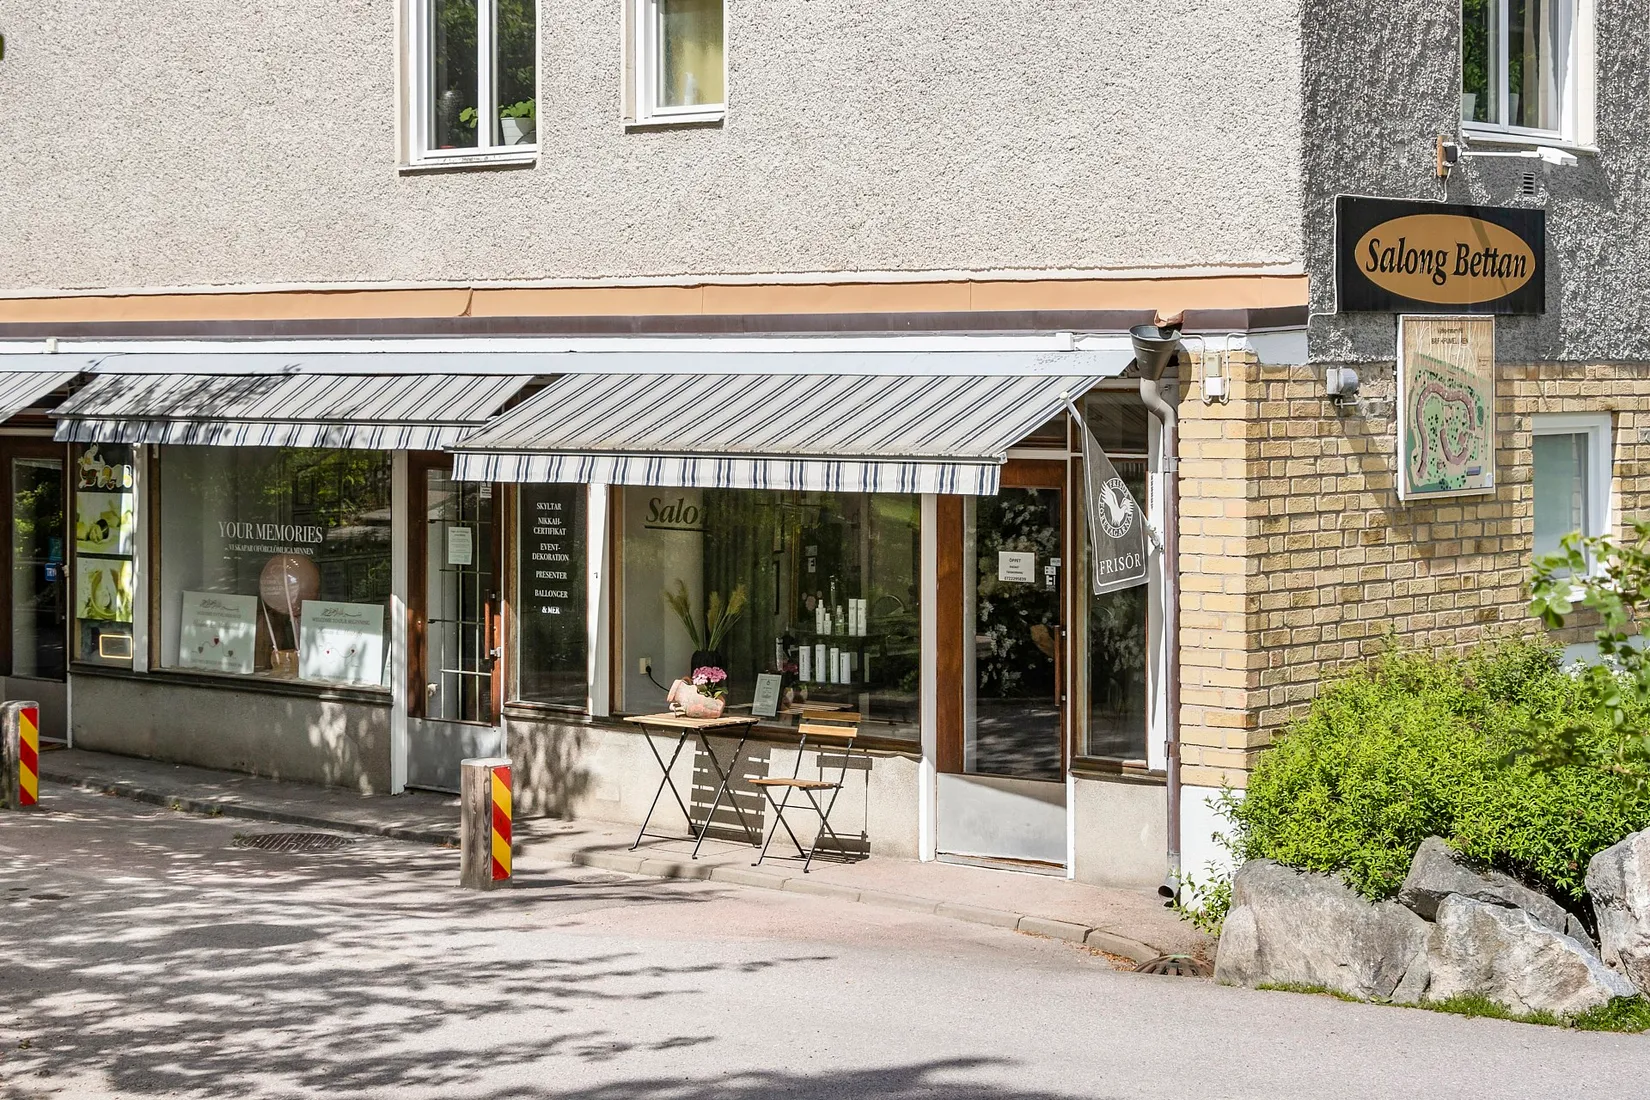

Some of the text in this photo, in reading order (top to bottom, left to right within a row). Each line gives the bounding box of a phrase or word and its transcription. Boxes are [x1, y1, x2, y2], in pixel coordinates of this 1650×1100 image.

[1365, 236, 1528, 286] Salong Bettan
[536, 502, 562, 510] SKYLTAR
[537, 517, 562, 525] NIKKAH-
[218, 521, 324, 544] YOUR MEMORIES
[533, 527, 567, 536] CERTIFIKAT
[540, 543, 561, 551] EVENT-
[532, 552, 569, 562] DEKORATION
[1099, 552, 1142, 575] FRISÖR
[535, 570, 568, 580] PRESENTER
[534, 589, 569, 599] BALLONGER
